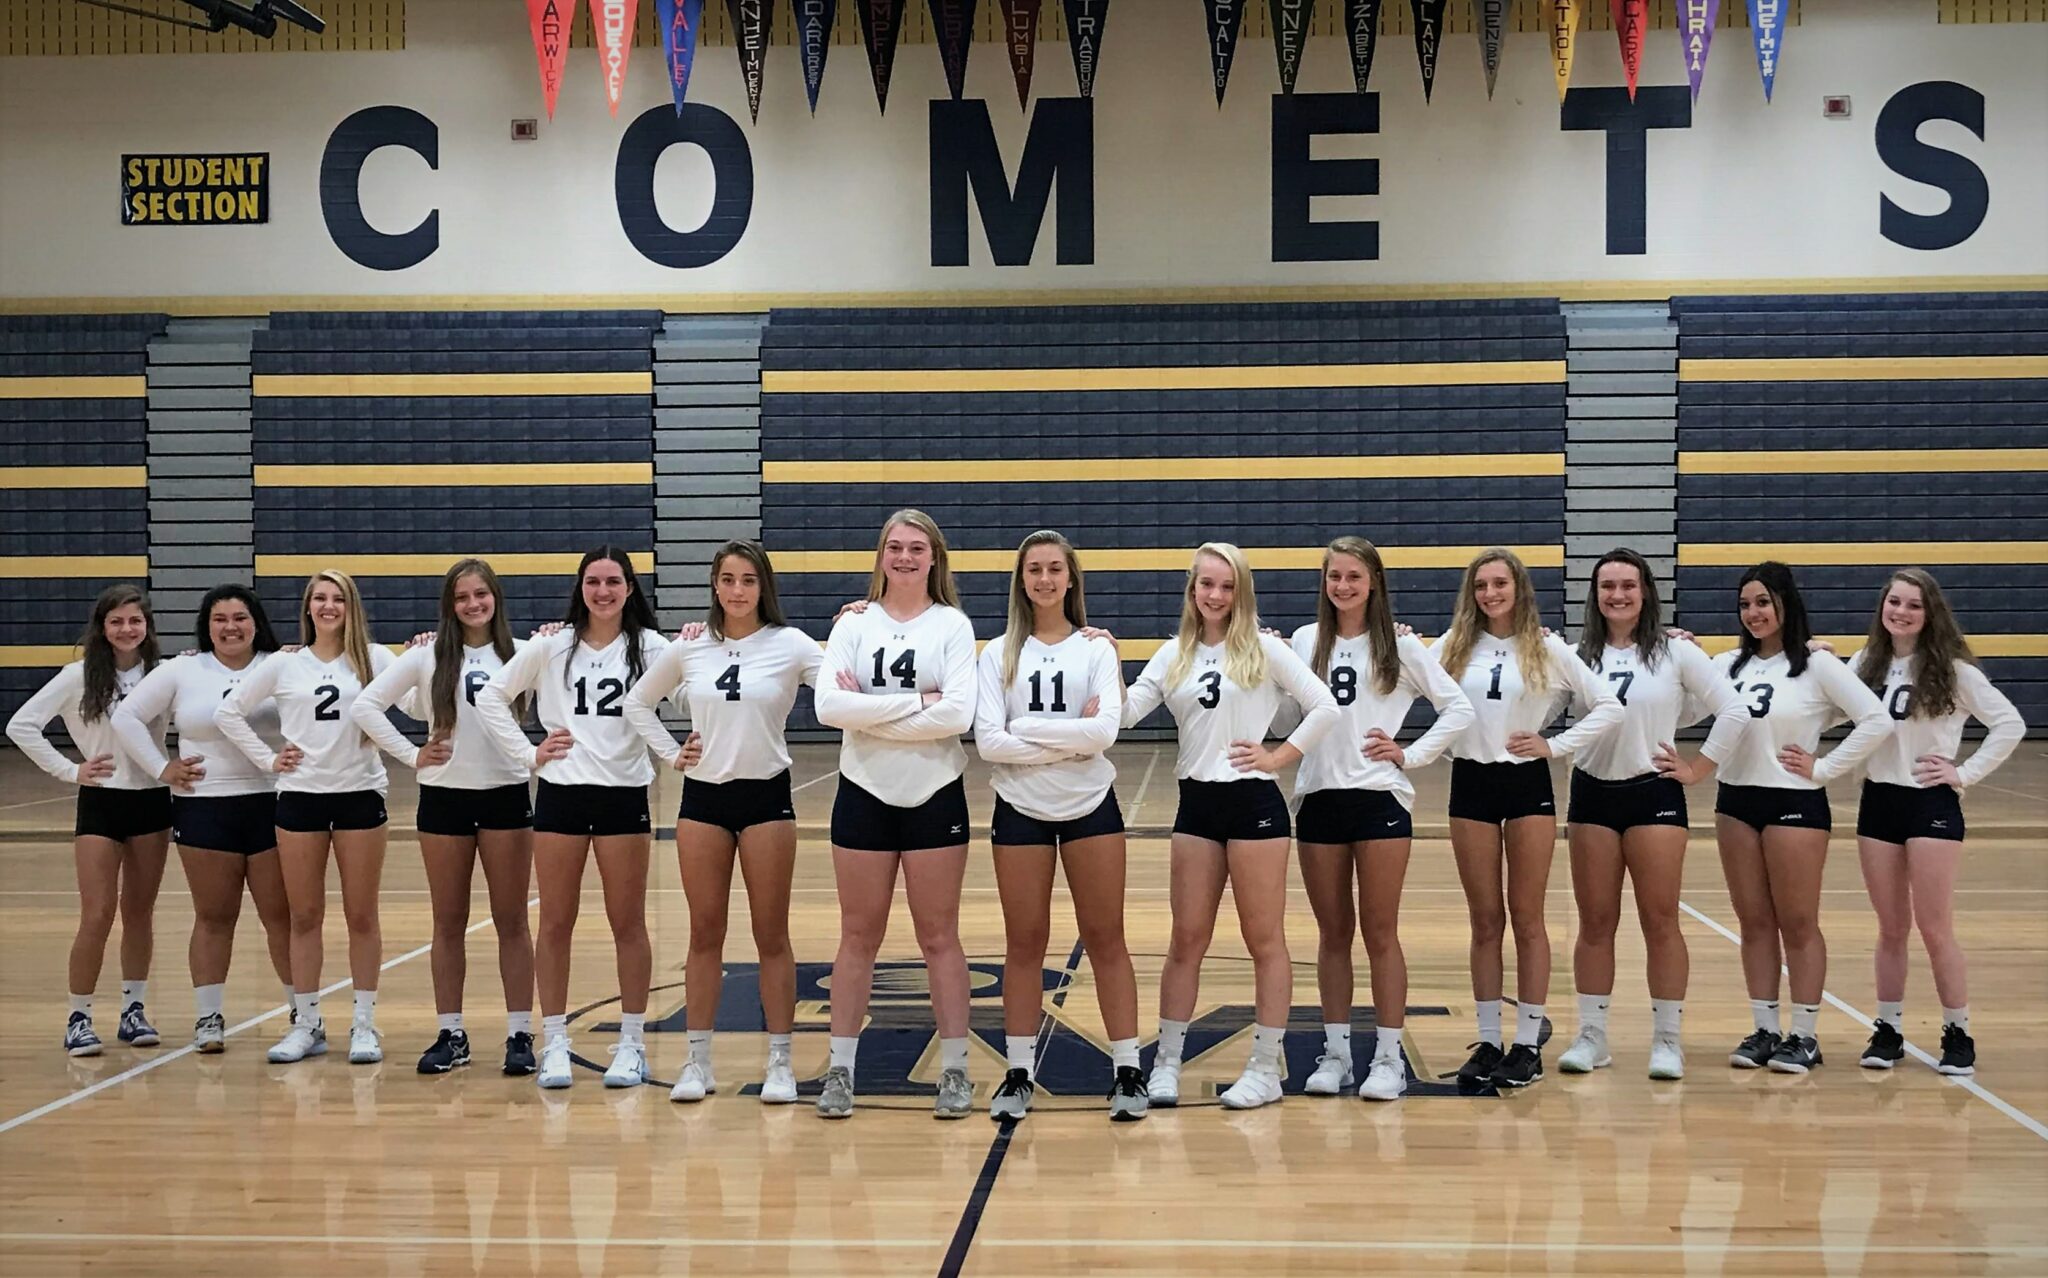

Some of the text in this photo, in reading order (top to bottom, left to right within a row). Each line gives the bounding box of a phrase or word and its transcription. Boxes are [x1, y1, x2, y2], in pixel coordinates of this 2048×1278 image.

[870, 0, 892, 95] MPFIELD
[1215, 0, 1231, 87] CALICO
[1353, 0, 1371, 95] ZABETHTOWN
[1420, 0, 1434, 79] LANCO
[128, 157, 264, 187] STUDENT
[319, 80, 1990, 270] COMETS
[131, 191, 259, 221] SECTION
[715, 664, 741, 701] 4
[871, 647, 917, 688] 14
[1331, 666, 1357, 706] 8
[1486, 663, 1503, 700] 1
[314, 685, 340, 721] 2
[574, 676, 623, 717] 12
[1028, 670, 1066, 712] 11
[1198, 671, 1222, 709] 3
[1608, 671, 1634, 706] 7
